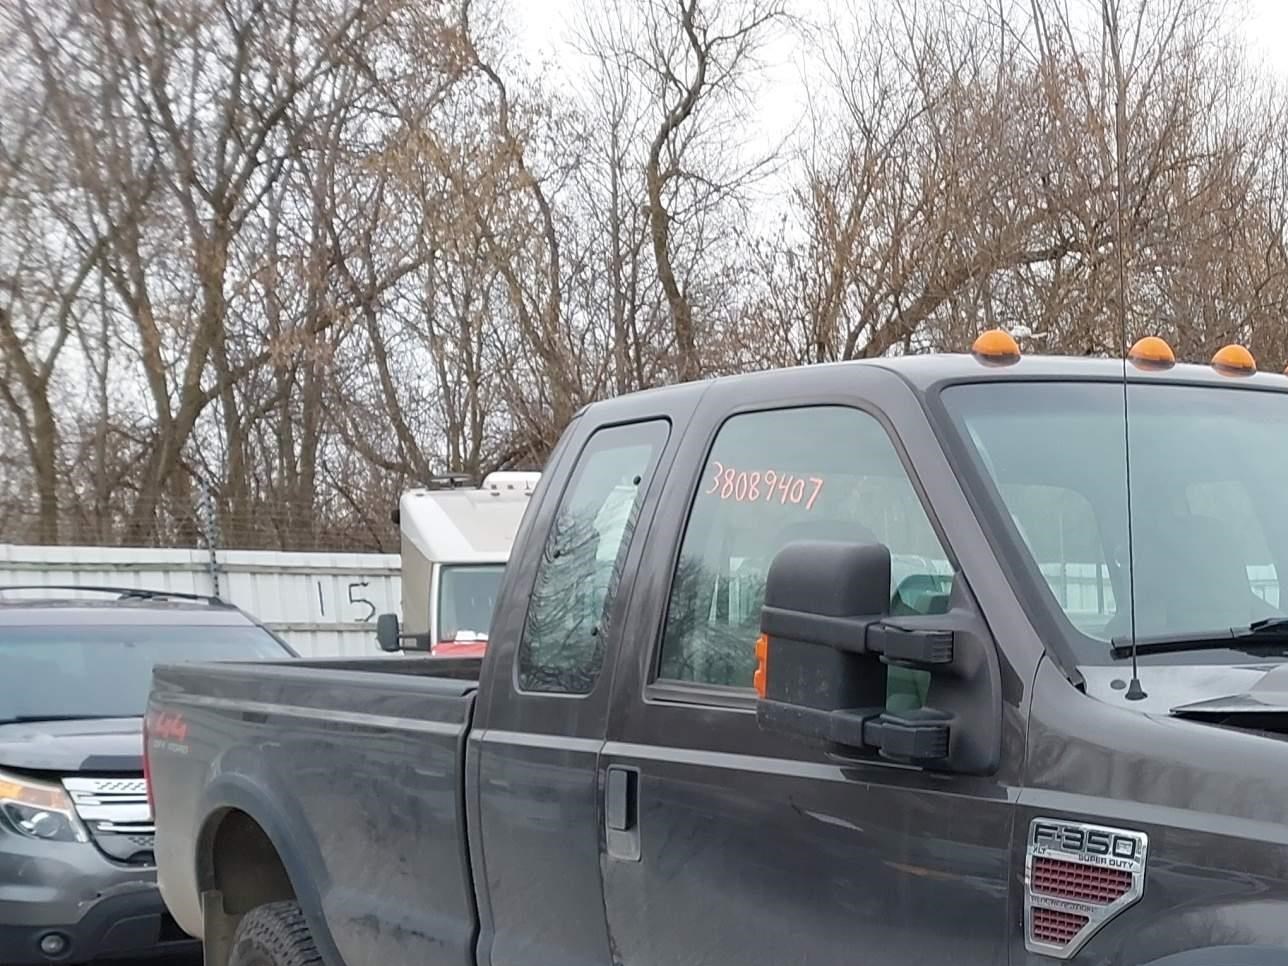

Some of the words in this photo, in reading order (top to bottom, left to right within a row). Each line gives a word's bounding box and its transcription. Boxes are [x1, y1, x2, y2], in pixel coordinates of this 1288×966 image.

[705, 461, 824, 510] 38089407
[1078, 854, 1106, 865] SUPER
[1108, 859, 1134, 870] DUTY
